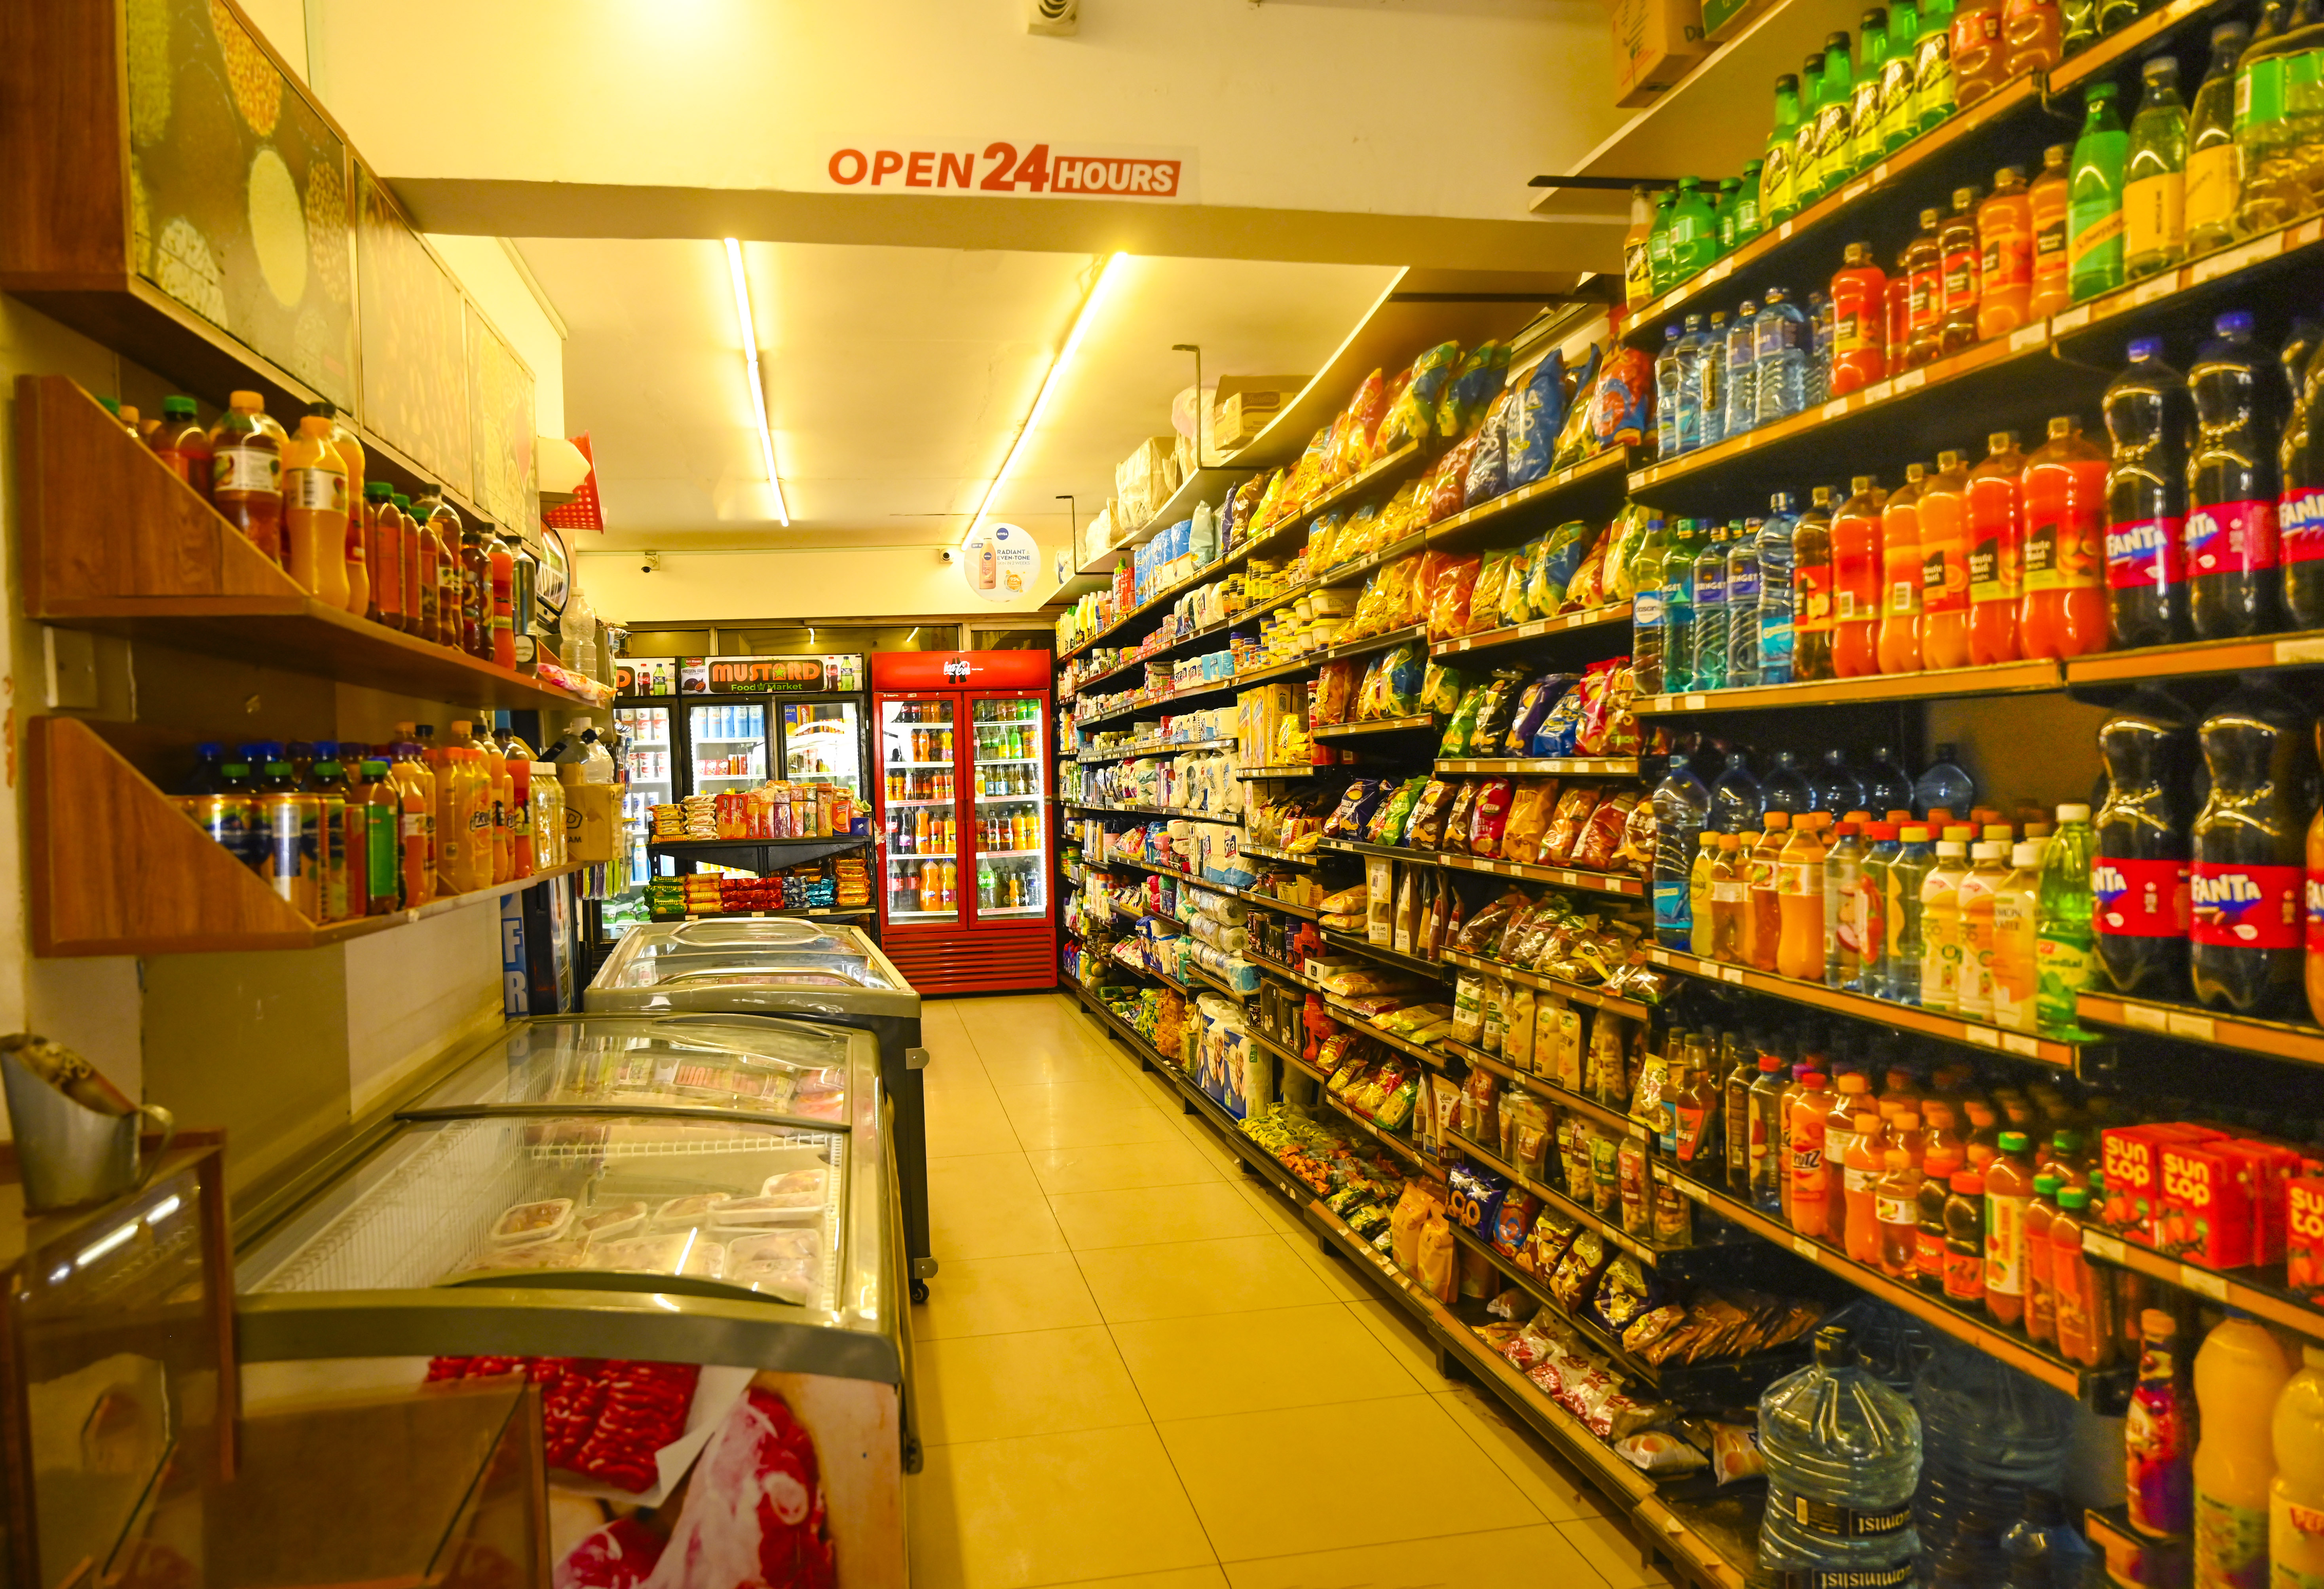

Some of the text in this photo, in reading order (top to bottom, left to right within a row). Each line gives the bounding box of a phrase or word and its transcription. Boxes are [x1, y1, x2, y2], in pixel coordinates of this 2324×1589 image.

[828, 142, 1174, 193] OPEN 24 HOURS
[2106, 525, 2166, 558] FANTA
[2186, 512, 2218, 544] NTA
[713, 663, 820, 682] MUSTARD
[2092, 868, 2127, 891] NTA
[2191, 874, 2261, 902] FANTA
[2105, 1136, 2149, 1164] sun
[2106, 1157, 2149, 1187] top
[2164, 1153, 2210, 1183] sun
[2165, 1174, 2210, 1207] top
[2290, 1187, 2324, 1213] su
[2291, 1210, 2324, 1238] to
